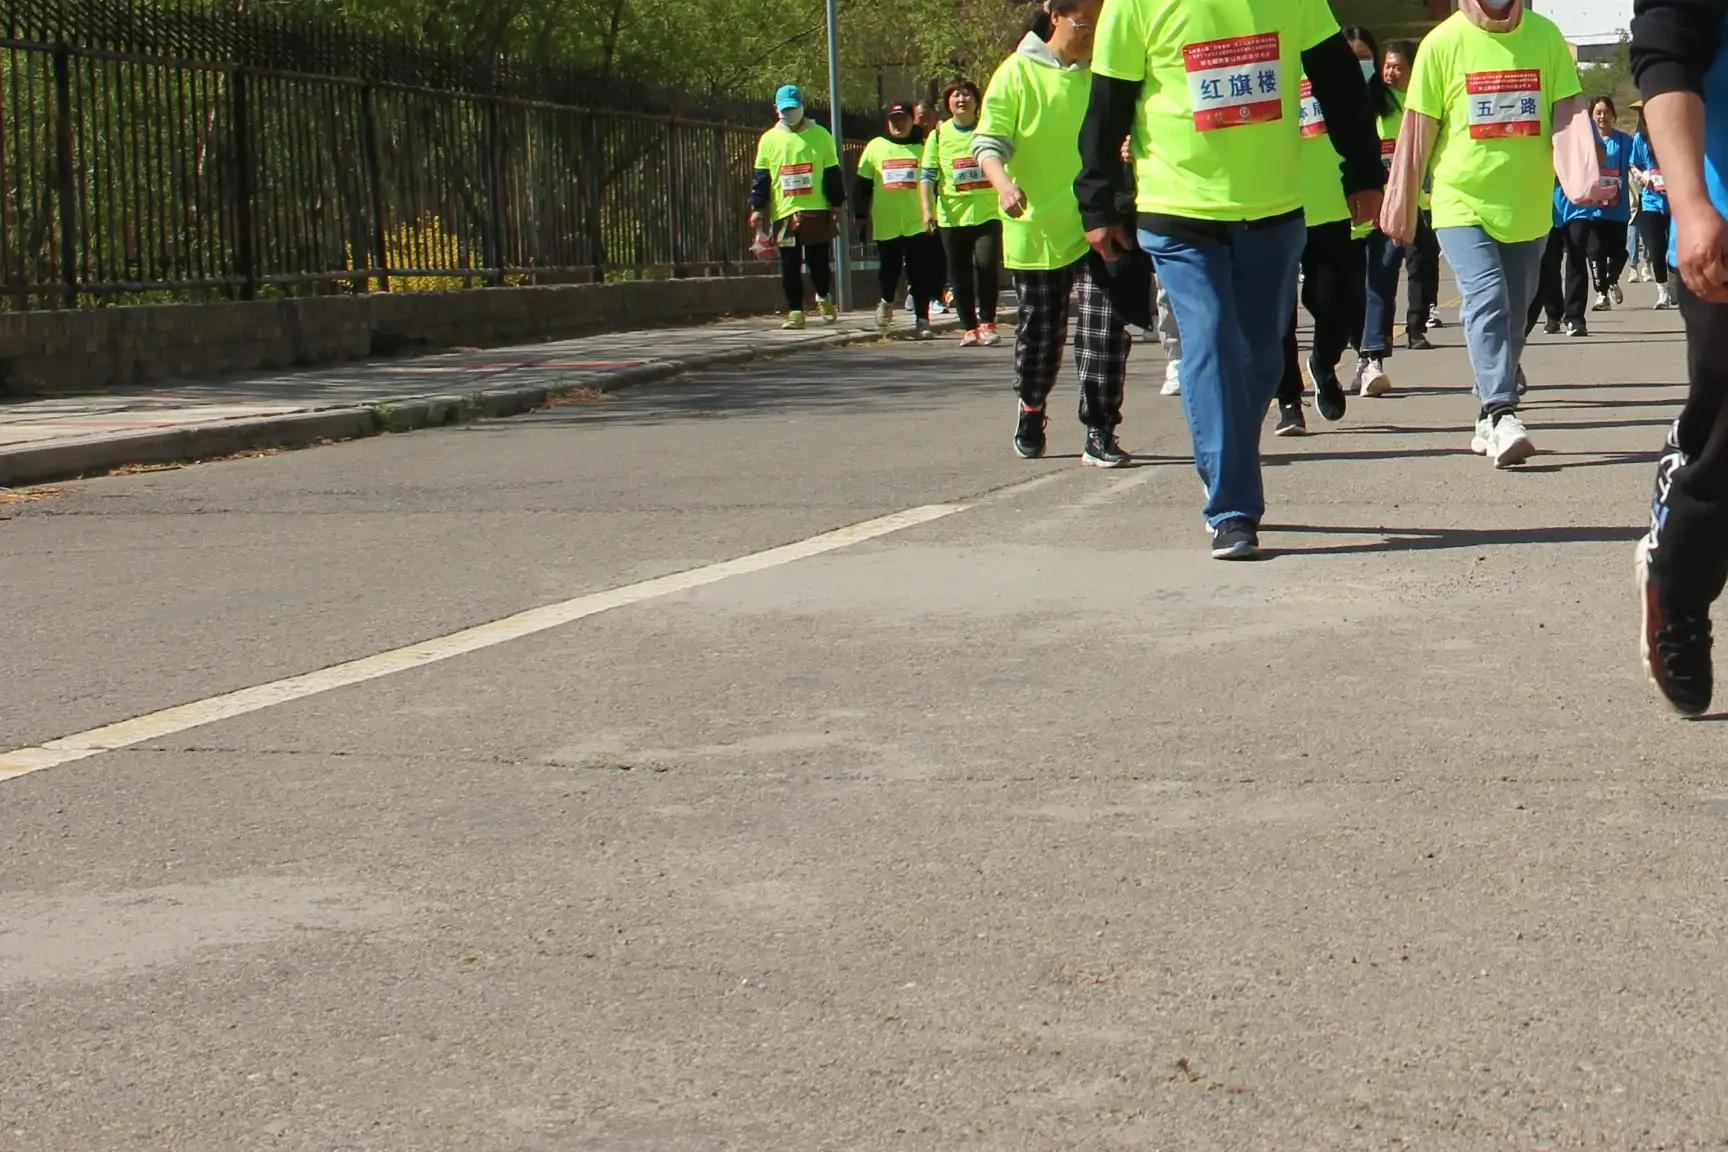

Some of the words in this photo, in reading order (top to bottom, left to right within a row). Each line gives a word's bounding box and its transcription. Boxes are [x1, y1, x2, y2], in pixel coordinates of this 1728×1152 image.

[1200, 69, 1276, 100] 红旗楼
[1477, 97, 1537, 118] 五一路
